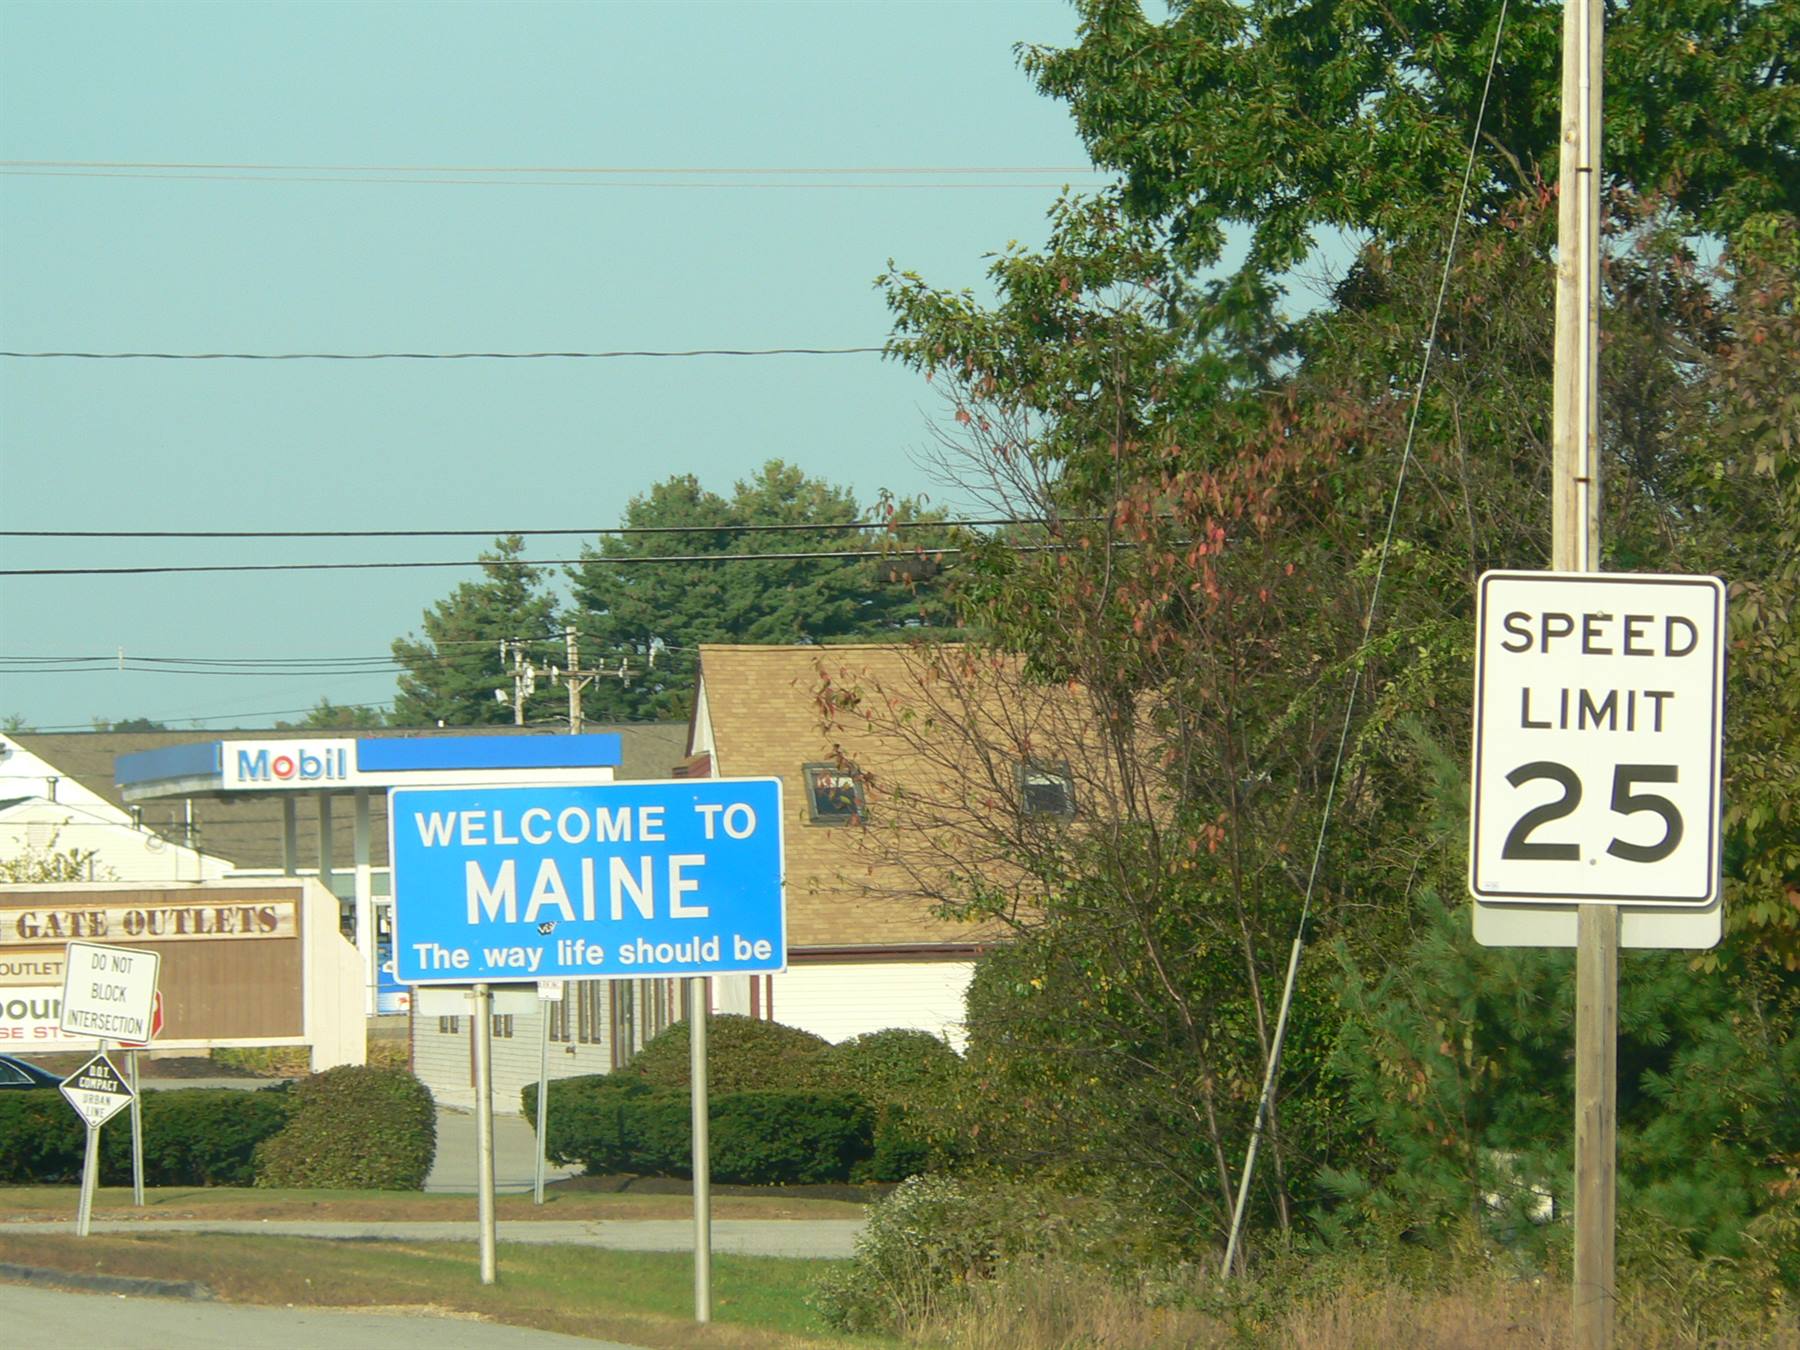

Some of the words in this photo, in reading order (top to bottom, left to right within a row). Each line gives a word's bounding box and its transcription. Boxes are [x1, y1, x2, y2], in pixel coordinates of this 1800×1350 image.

[1501, 611, 1699, 657] SPEED
[1521, 687, 1675, 732] LIMIT
[237, 748, 346, 781] Mobil
[414, 806, 666, 847] WELCOME
[694, 802, 757, 840] TO
[1501, 760, 1684, 863] 25
[465, 854, 709, 925] MAINE
[16, 911, 108, 939] GATE
[122, 905, 278, 936] OUTLETS
[91, 953, 106, 971] DO
[111, 956, 133, 974] NOT
[413, 943, 470, 970] The
[483, 947, 544, 972] way
[557, 939, 604, 967] life
[618, 935, 719, 964] should
[733, 934, 772, 960] be
[91, 982, 127, 1002] BLOCK
[67, 1009, 143, 1035] INTERSECTION
[78, 1076, 118, 1092] COMPACT
